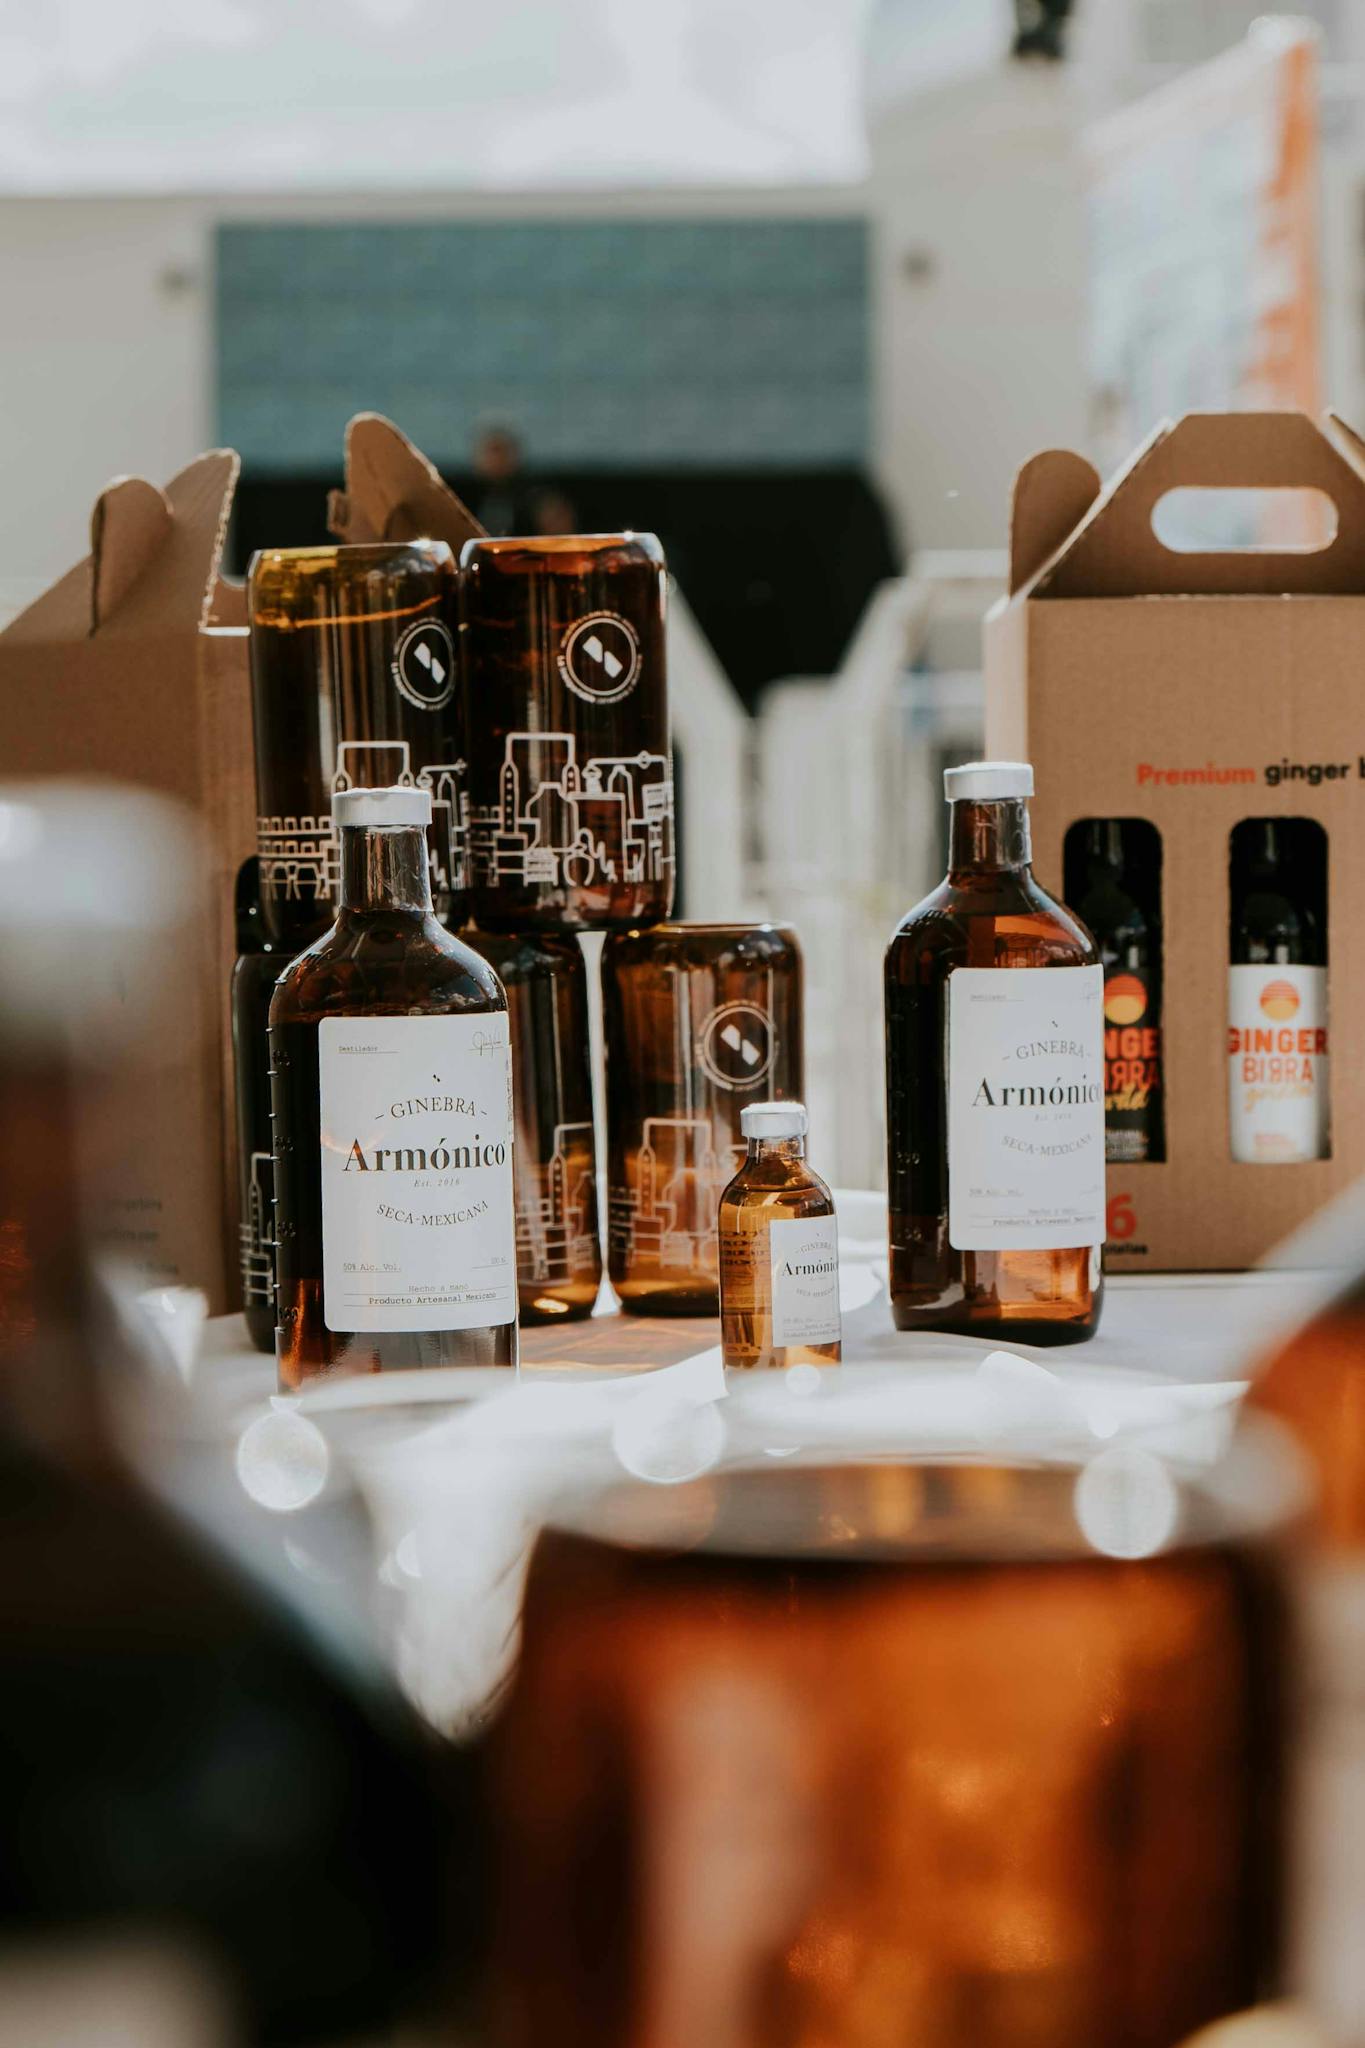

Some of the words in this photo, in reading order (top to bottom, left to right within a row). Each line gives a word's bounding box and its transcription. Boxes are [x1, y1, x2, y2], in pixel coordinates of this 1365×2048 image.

[1137, 762, 1256, 785] Premium
[1264, 758, 1350, 787] ginger
[1016, 1040, 1084, 1060] GINEBRA
[1227, 1026, 1329, 1055] GINGER
[391, 1096, 476, 1119] GINEBRA
[342, 1134, 506, 1172] Armónico
[376, 1200, 489, 1226] SECA-MEXICANA
[1104, 1193, 1138, 1239] 6
[369, 1297, 412, 1305] Producto
[416, 1295, 462, 1304] Artesanal
